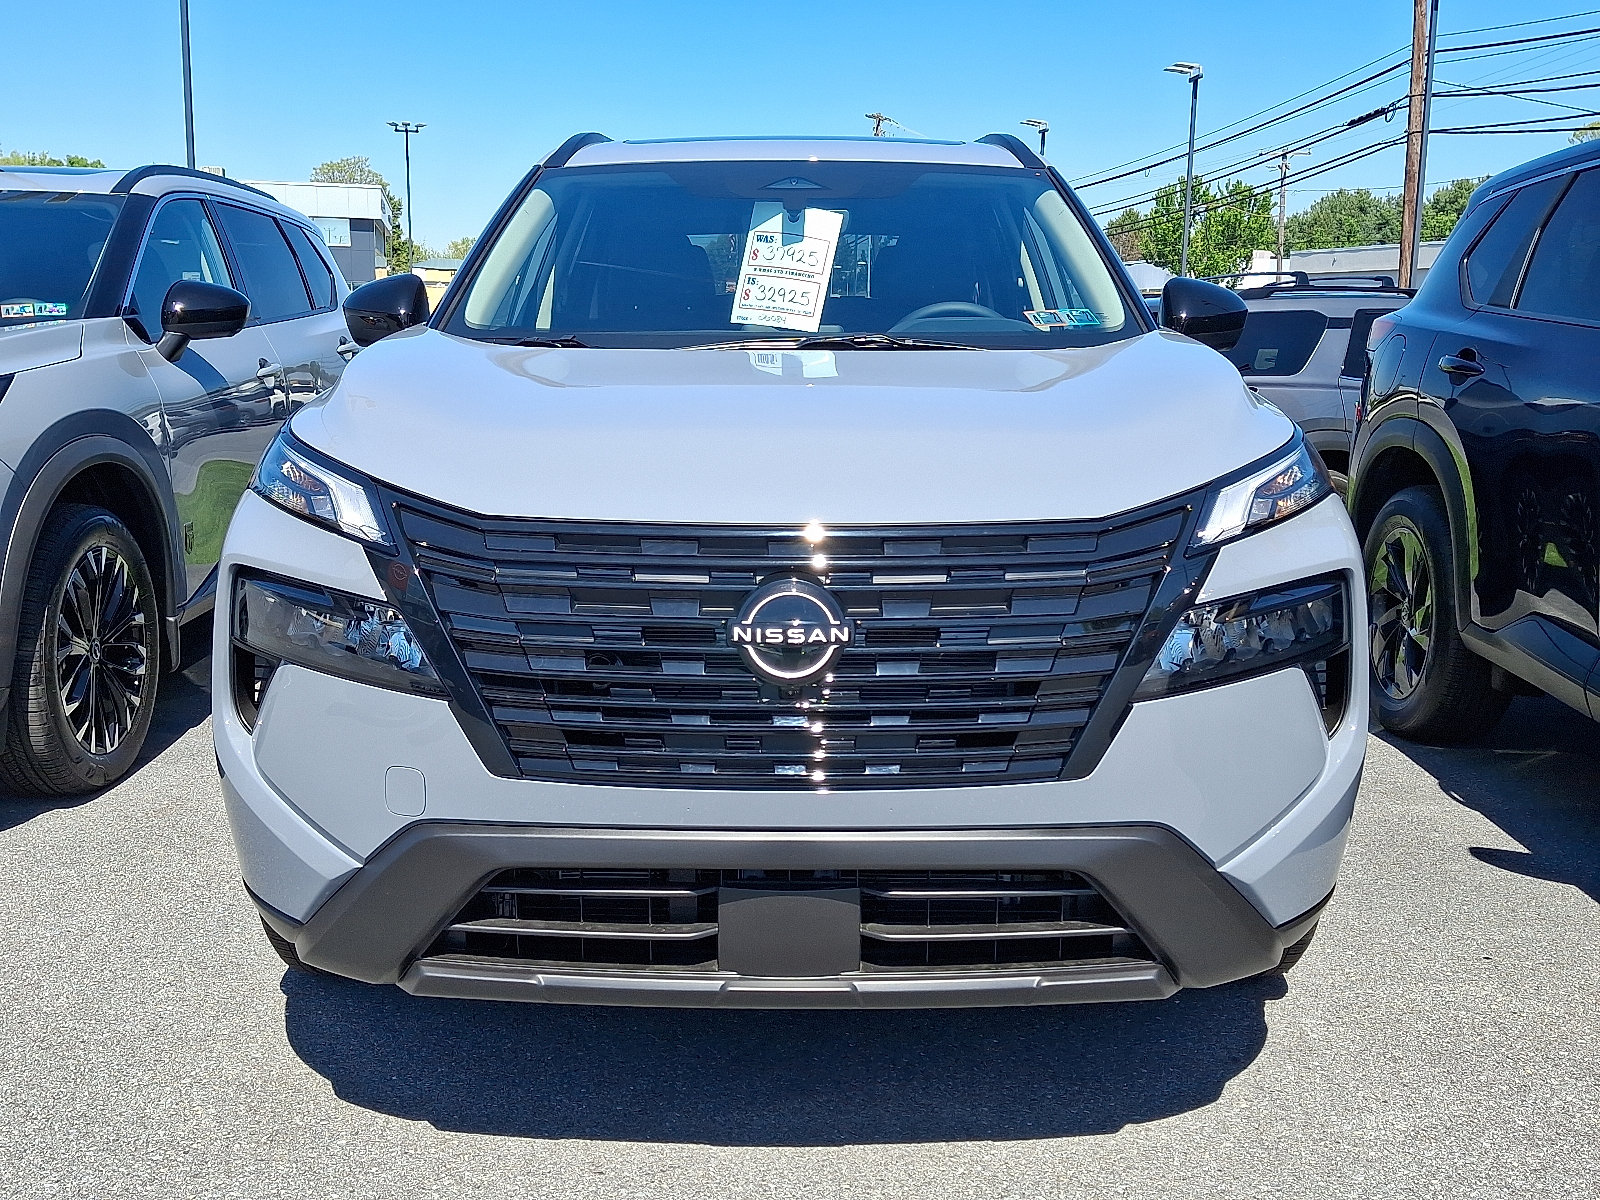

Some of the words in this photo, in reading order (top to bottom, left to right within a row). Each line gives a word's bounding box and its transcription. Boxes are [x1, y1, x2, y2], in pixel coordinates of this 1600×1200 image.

[756, 234, 778, 244] WAS:
[762, 245, 819, 267] 37925
[746, 276, 760, 286] IS:
[754, 284, 812, 307] 32925
[733, 626, 849, 644] NISSAN
